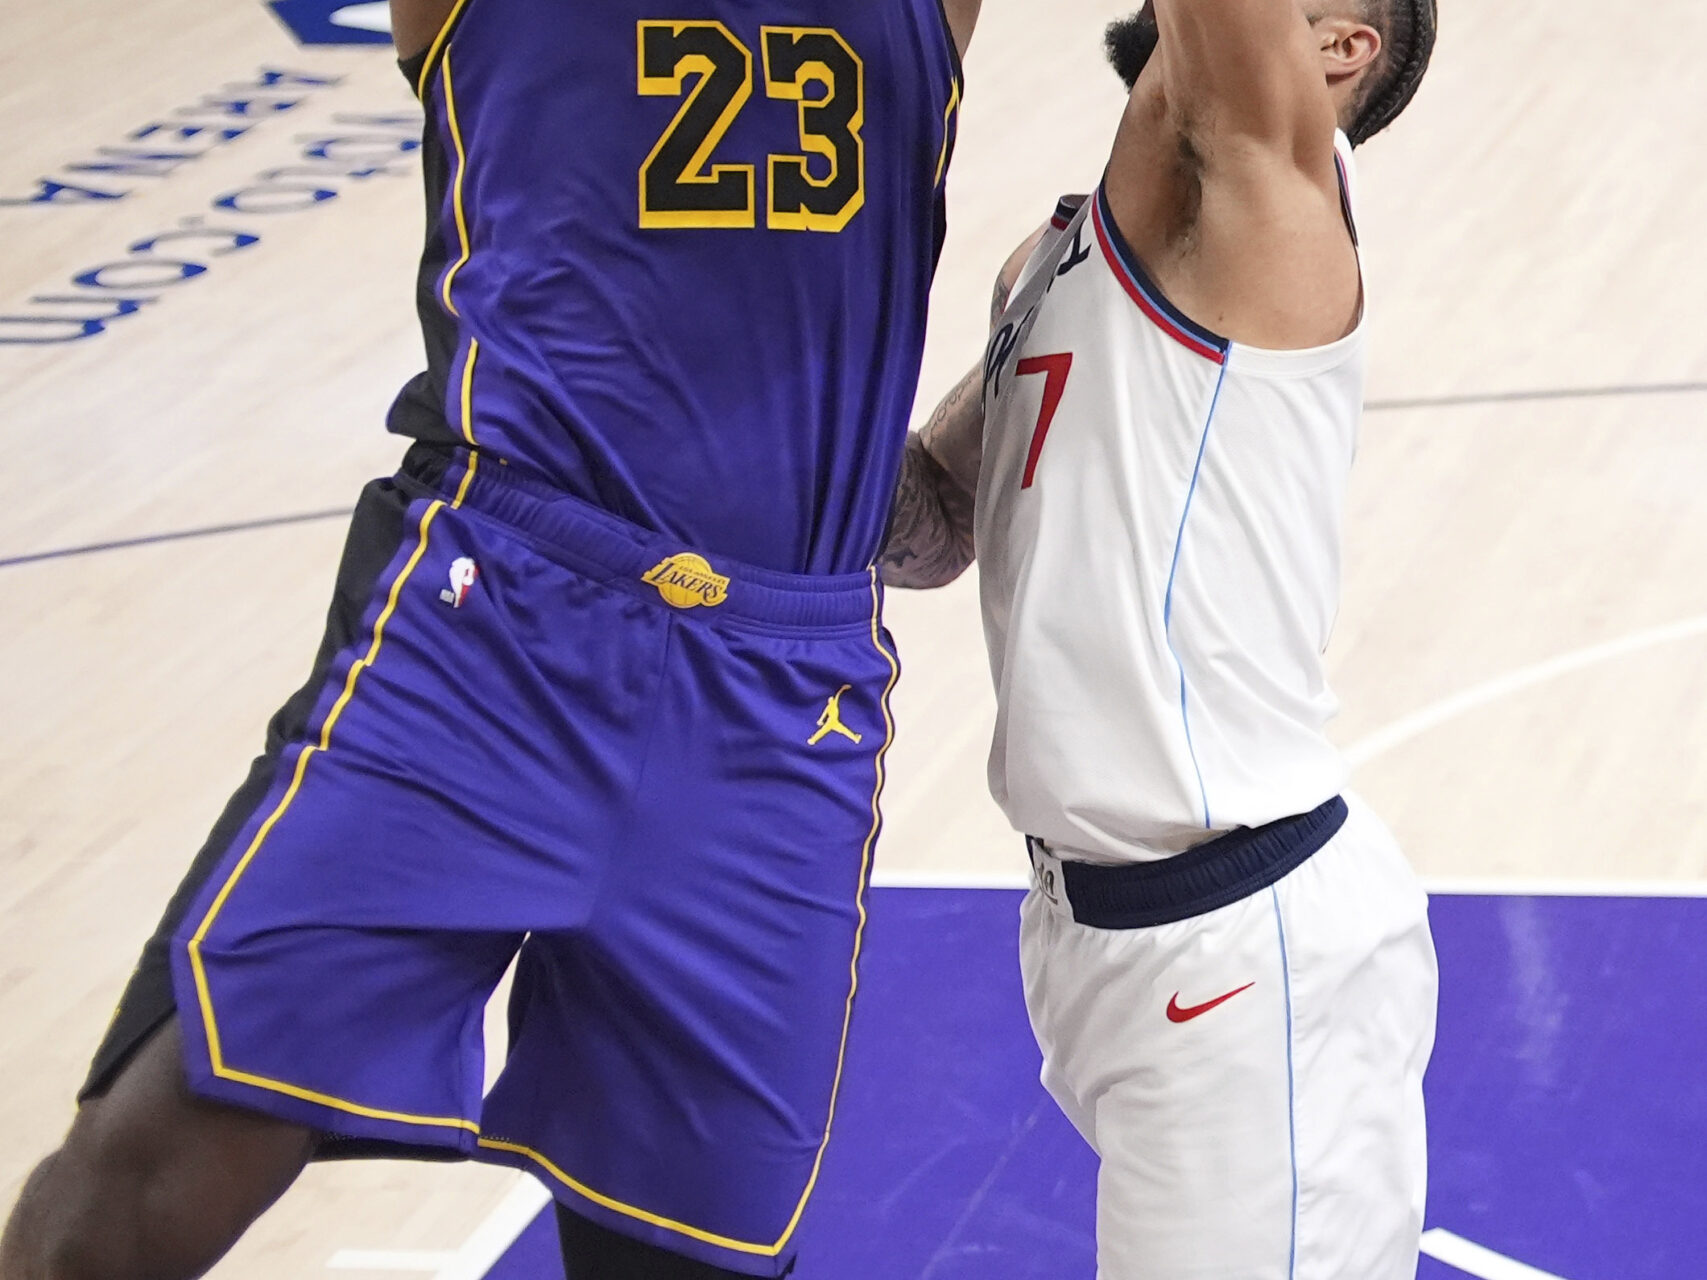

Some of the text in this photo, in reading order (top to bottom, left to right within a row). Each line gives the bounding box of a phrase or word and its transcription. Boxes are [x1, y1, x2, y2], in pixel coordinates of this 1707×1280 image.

[636, 19, 866, 233] 23
[1015, 352, 1073, 490] 7
[652, 562, 723, 603] LAKERS
